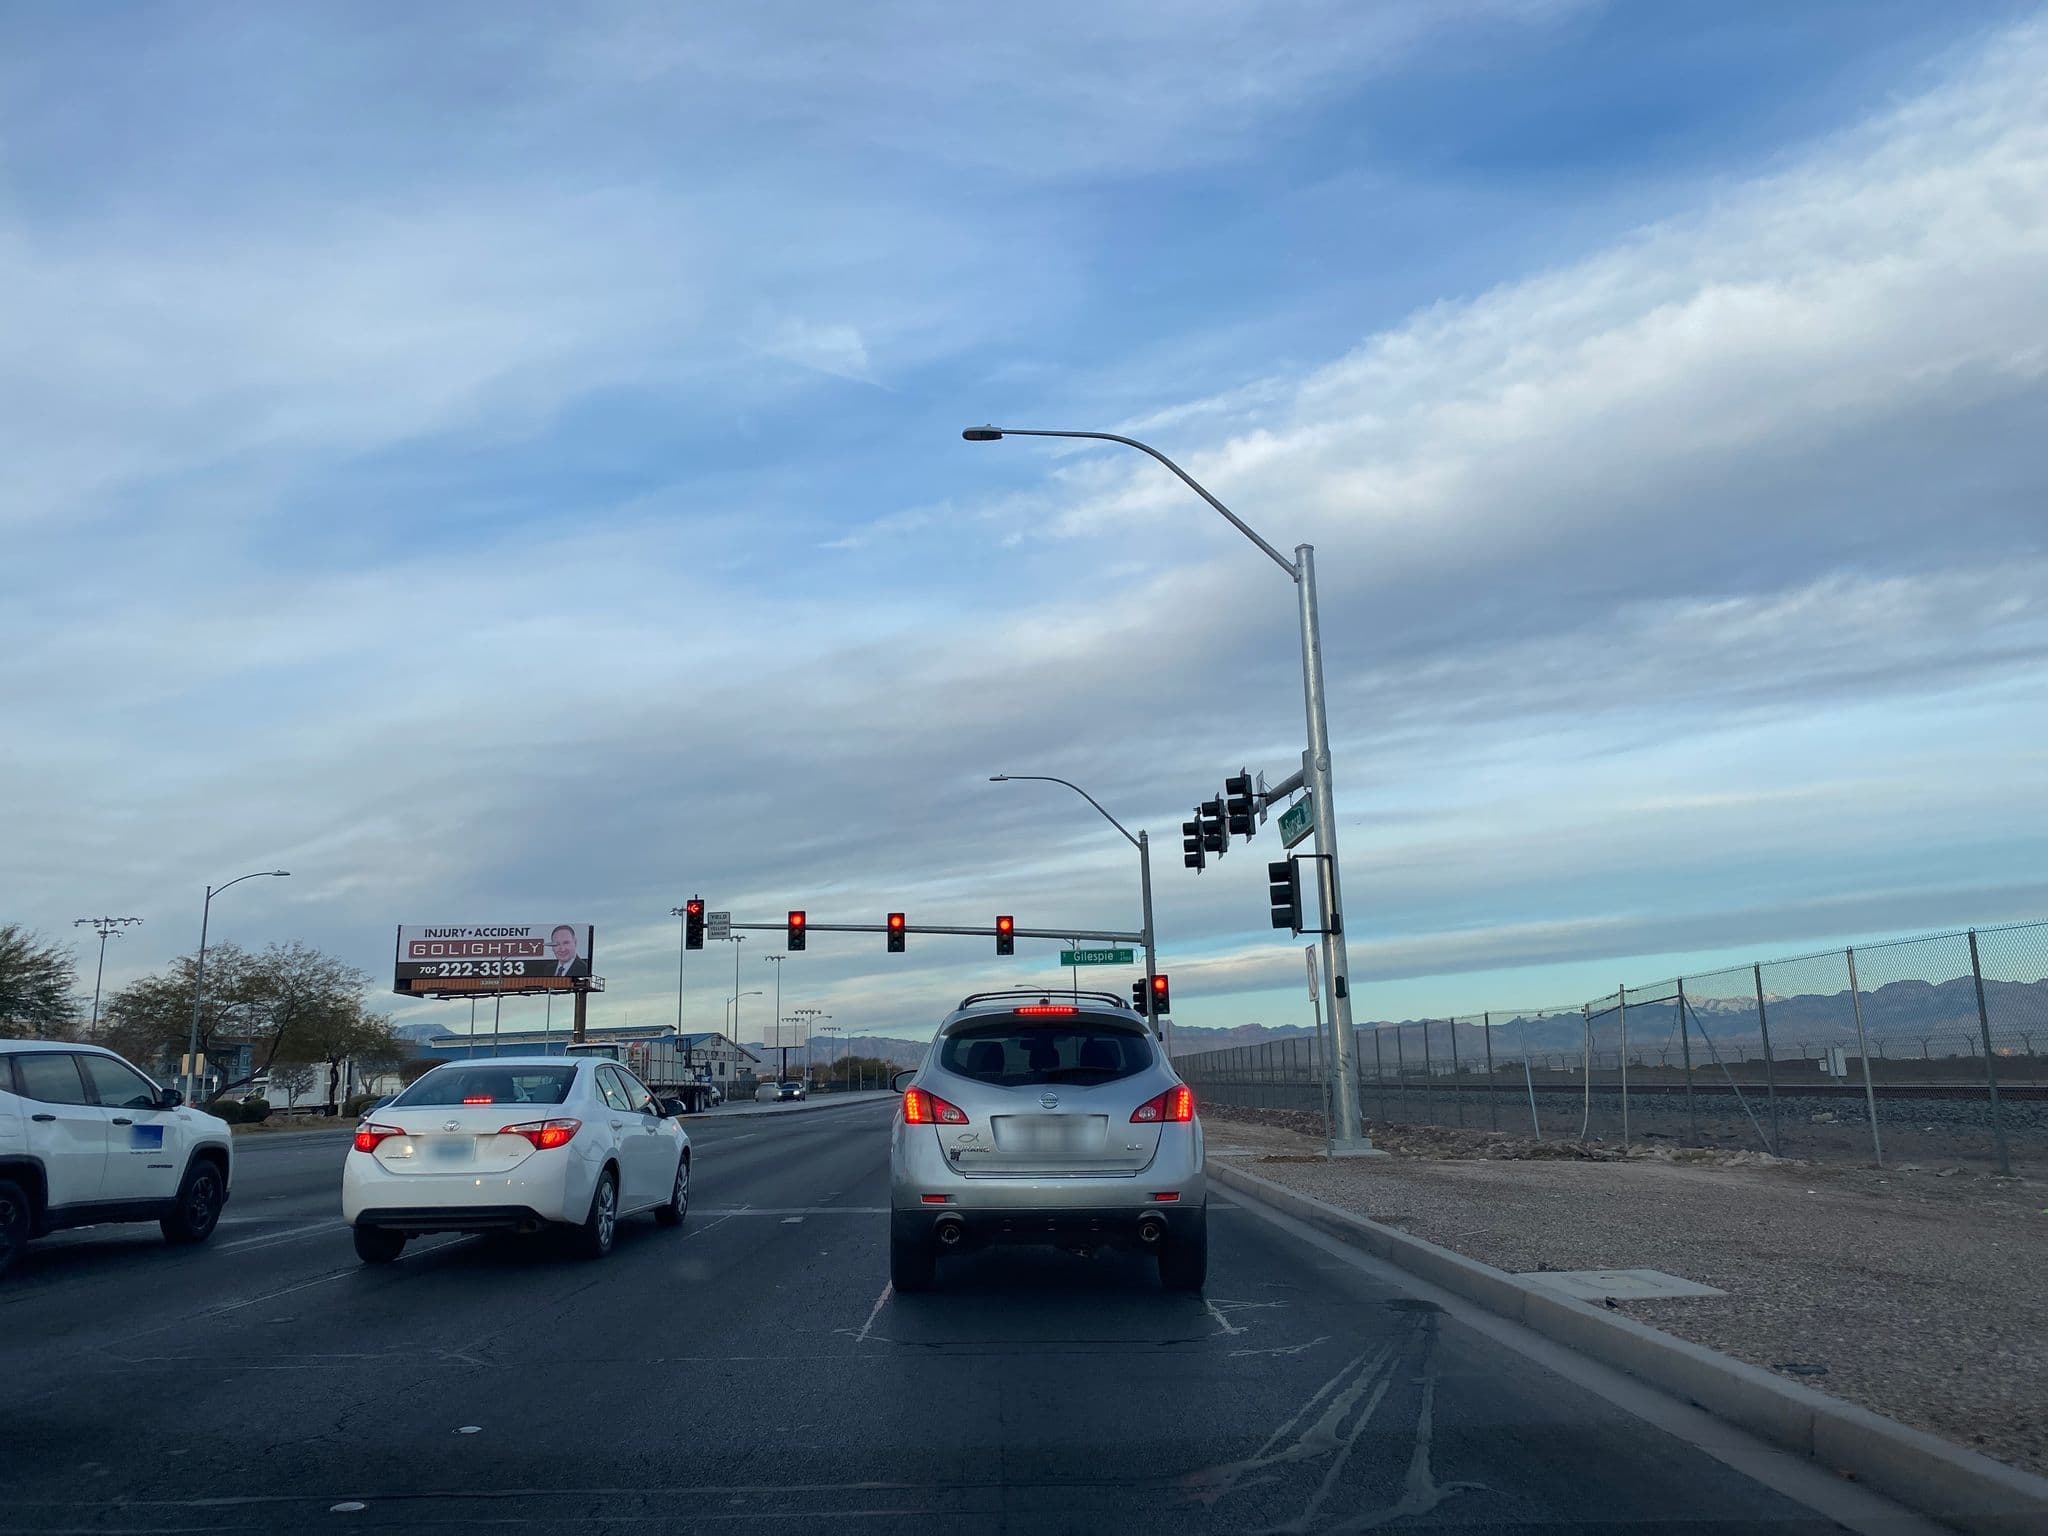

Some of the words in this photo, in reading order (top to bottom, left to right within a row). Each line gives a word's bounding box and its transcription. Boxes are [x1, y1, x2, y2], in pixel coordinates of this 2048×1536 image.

[424, 928, 466, 938] INJURY
[474, 927, 530, 937] ACCIDENT
[413, 942, 541, 956] GOLIGHTLY
[1073, 951, 1114, 963] Gilespie
[438, 962, 525, 977] 222-3333
